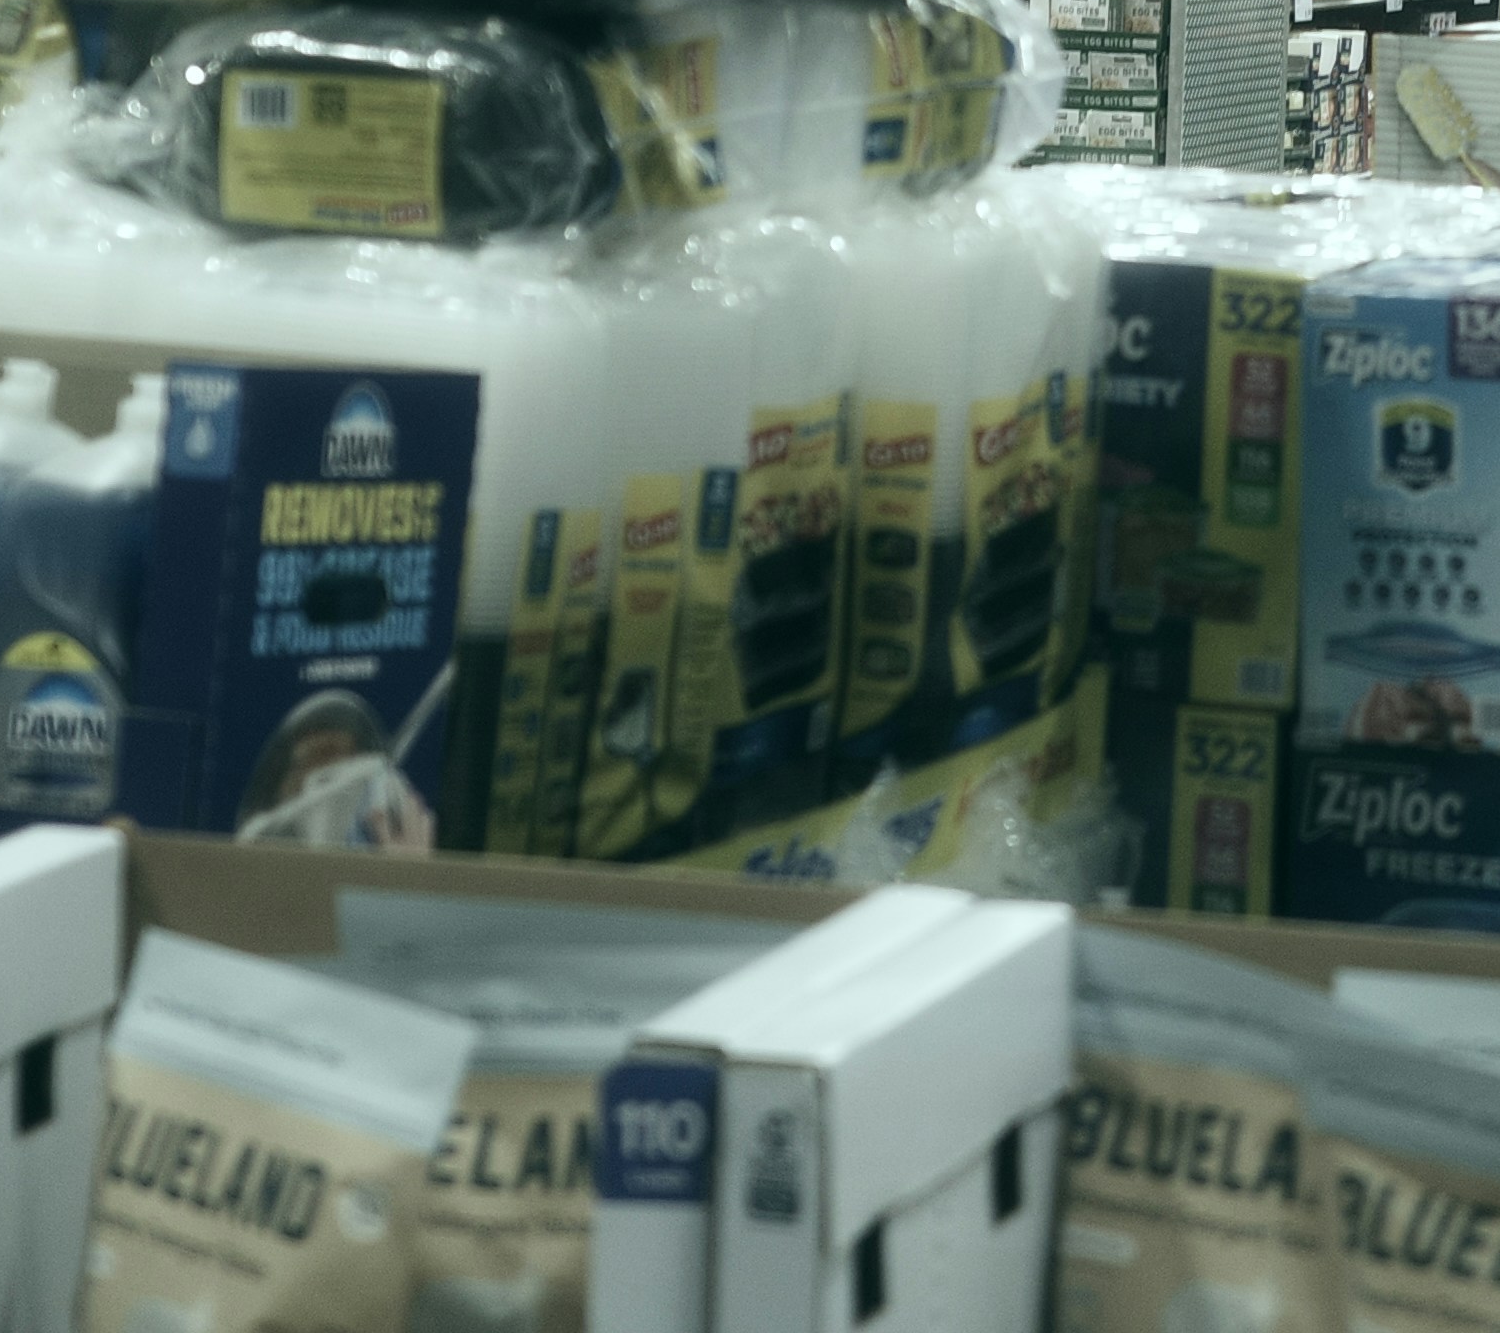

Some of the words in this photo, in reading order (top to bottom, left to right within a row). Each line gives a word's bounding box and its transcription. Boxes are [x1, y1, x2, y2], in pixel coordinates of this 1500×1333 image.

[1219, 293, 1300, 332] 322
[1323, 333, 1435, 386] Ziploc
[1318, 775, 1465, 844] Ziploc
[617, 1099, 702, 1160] 110
